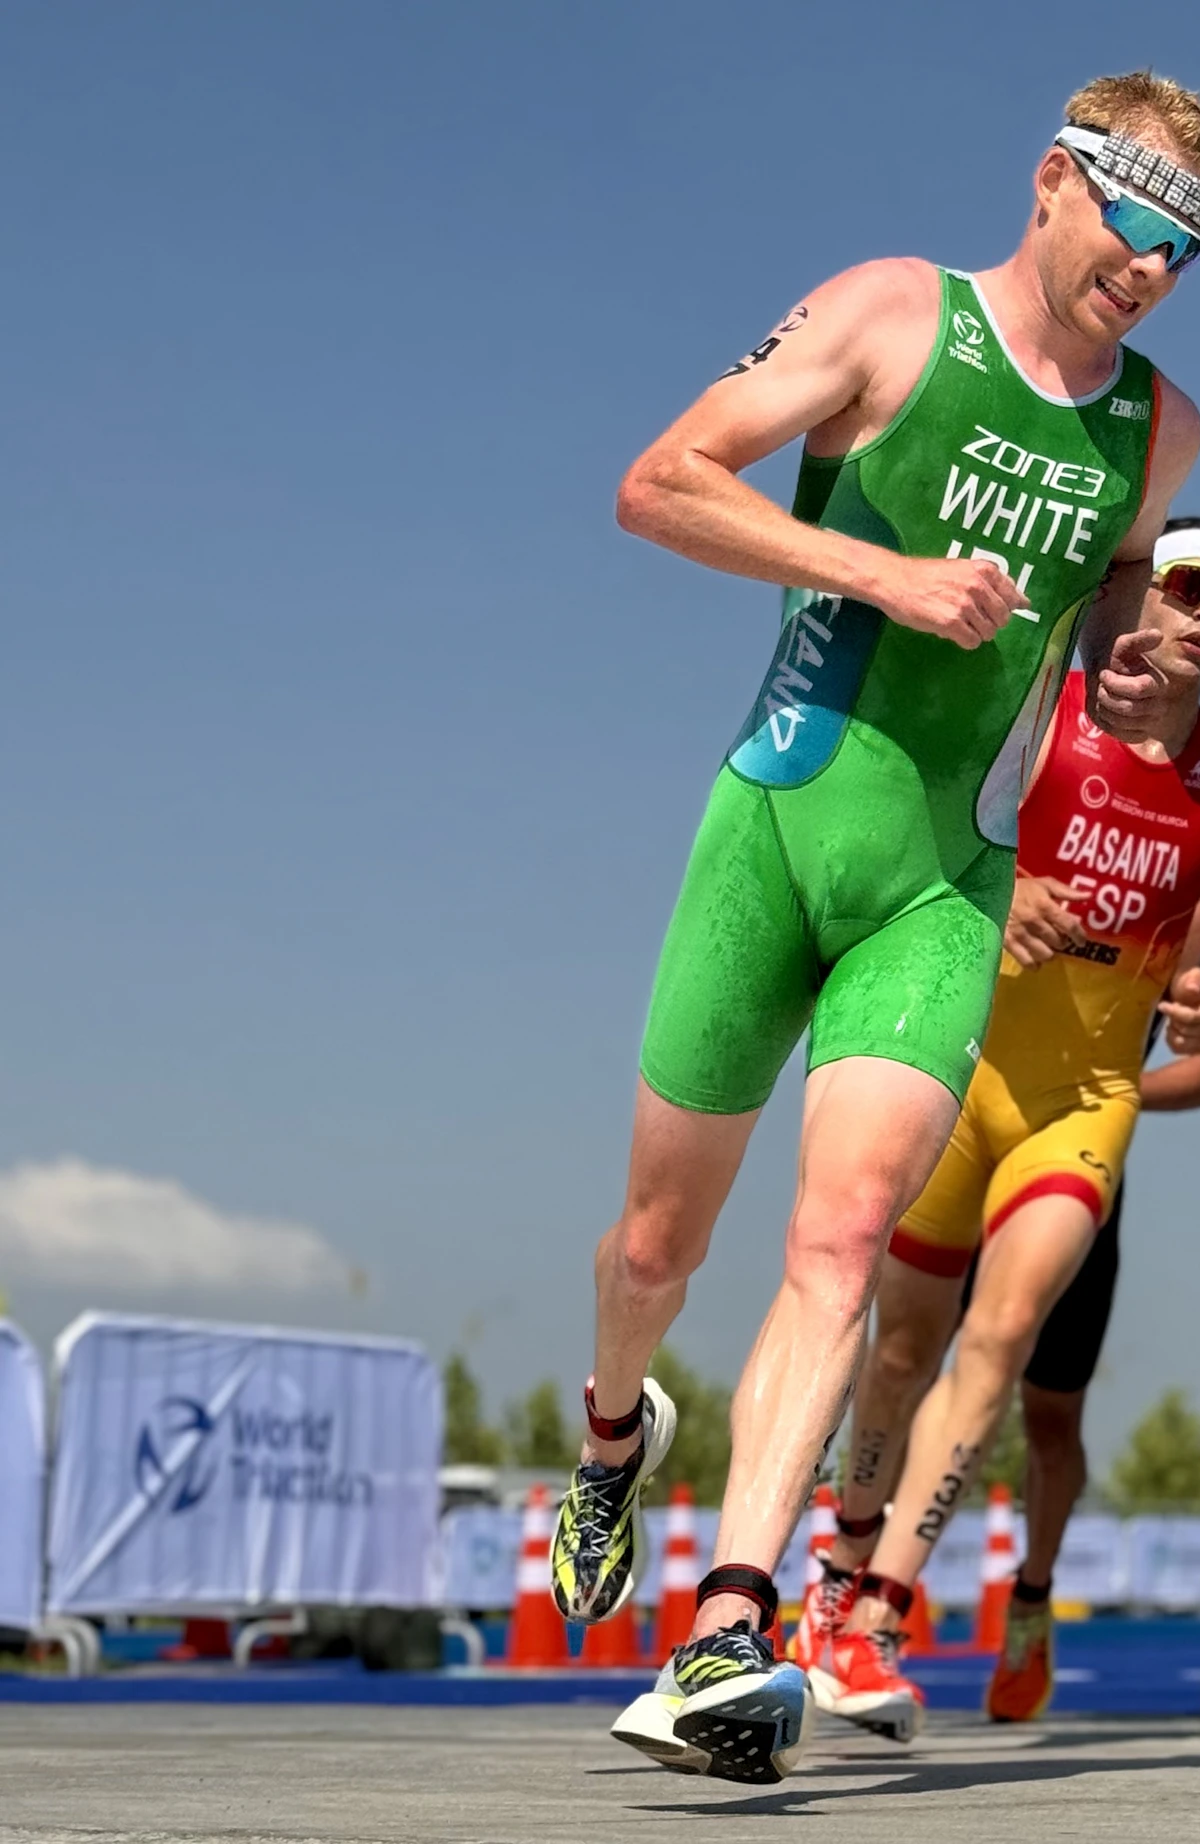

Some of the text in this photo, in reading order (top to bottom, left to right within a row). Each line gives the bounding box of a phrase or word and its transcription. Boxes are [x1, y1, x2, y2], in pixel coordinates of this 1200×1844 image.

[960, 424, 1107, 498] ZONE3
[938, 463, 1100, 565] WHITE
[1056, 813, 1181, 893] BASANTA
[229, 1406, 333, 1452] World
[230, 1455, 374, 1508] Triathlon
